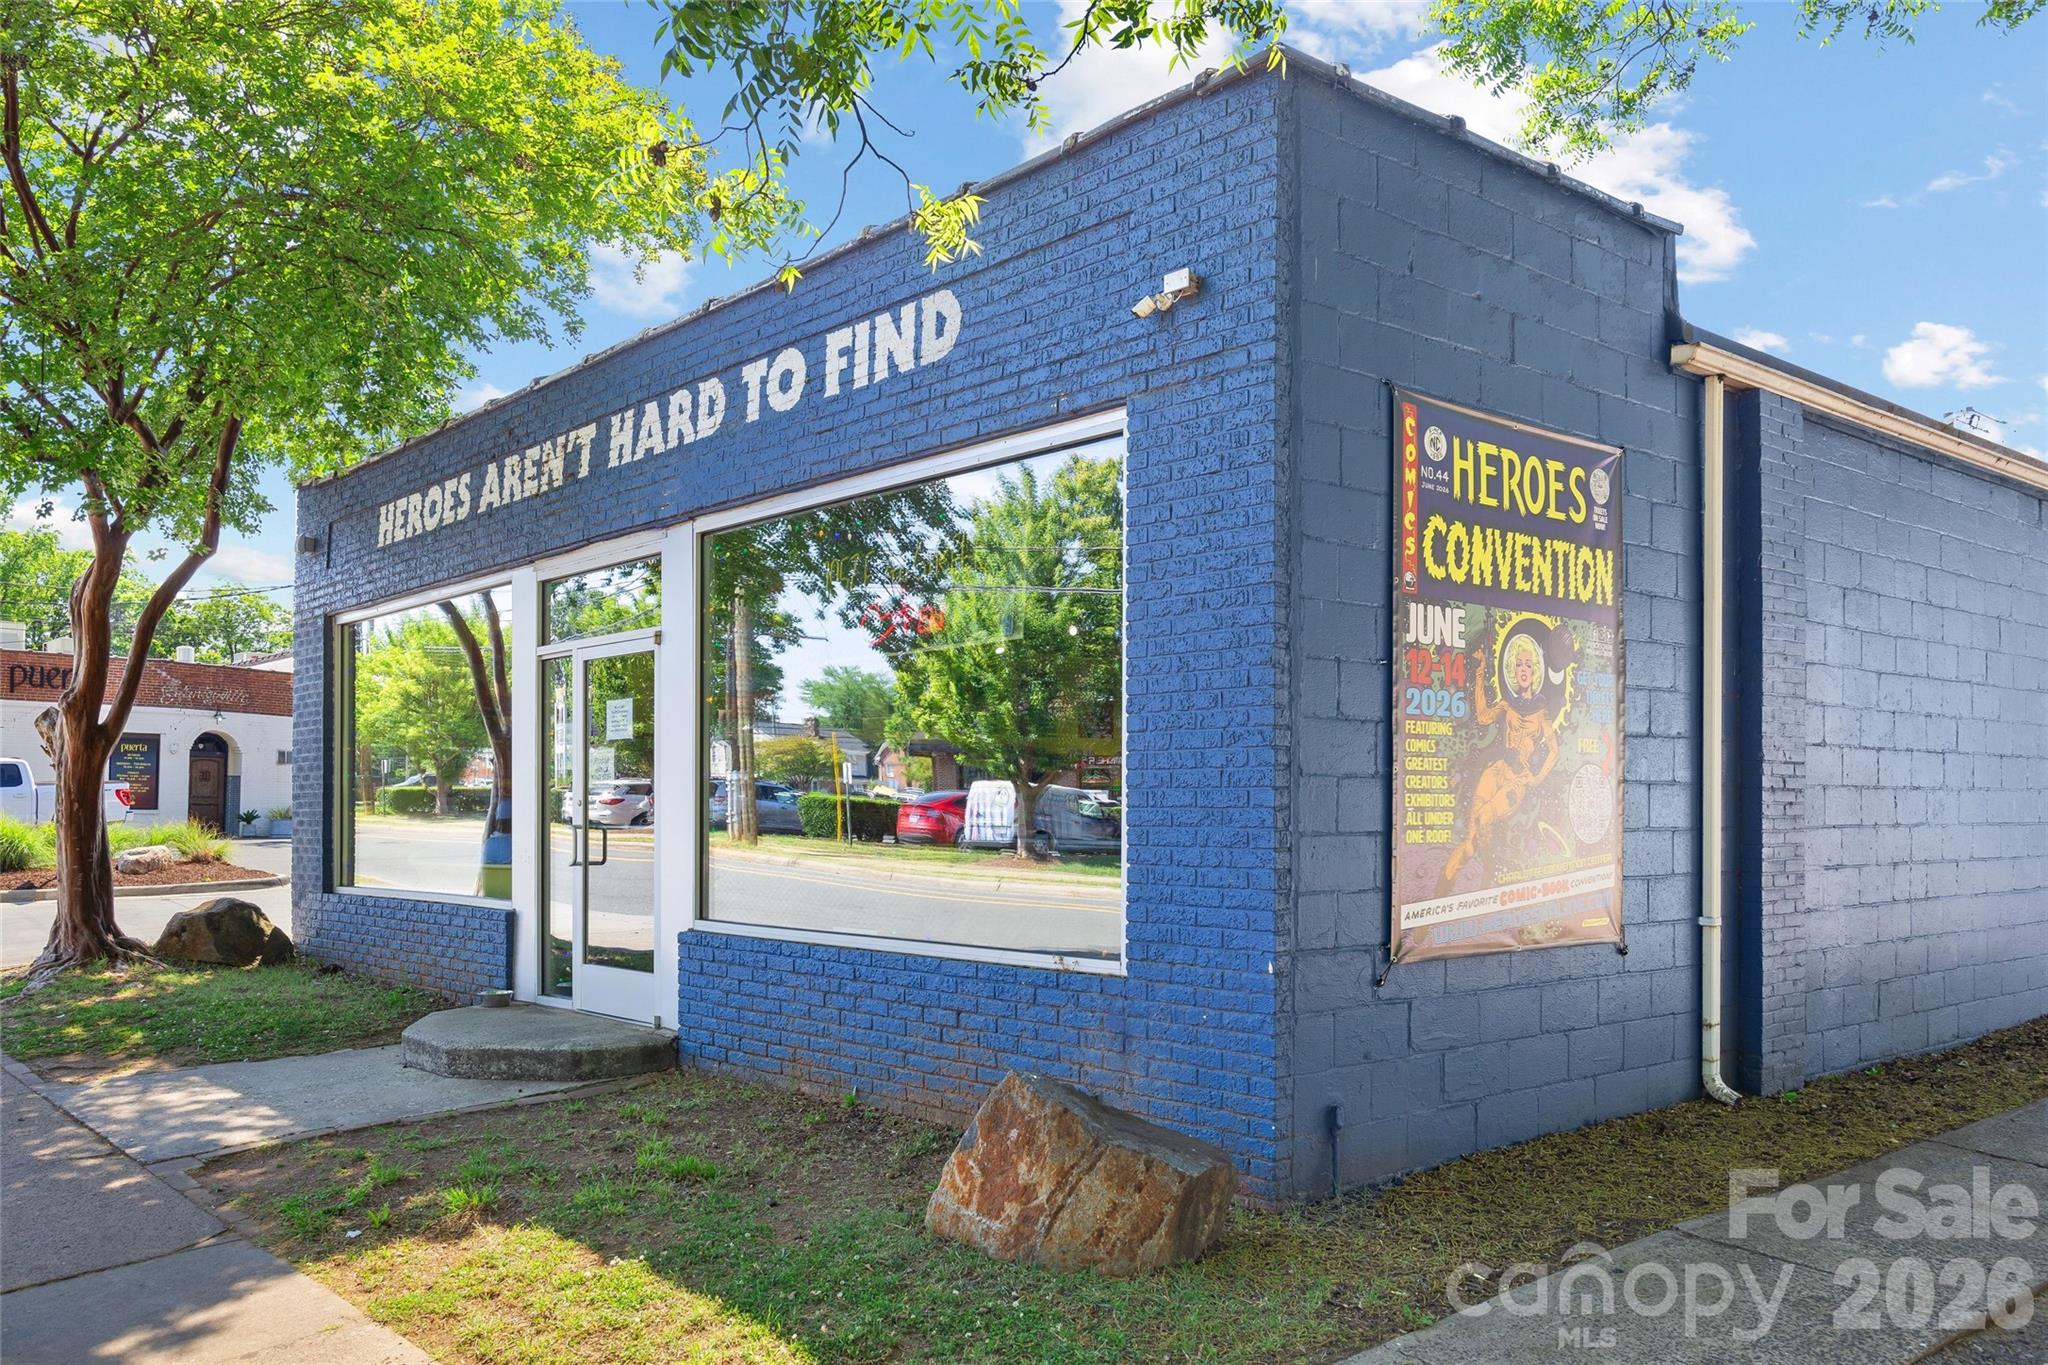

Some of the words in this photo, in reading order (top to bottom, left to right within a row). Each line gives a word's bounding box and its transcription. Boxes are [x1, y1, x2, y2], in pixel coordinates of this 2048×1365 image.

[377, 473, 471, 548] HEROES
[478, 422, 597, 513] AREN'T
[608, 377, 726, 468] HARD
[742, 347, 807, 424] TO
[824, 289, 963, 398] FIND
[1420, 465, 1449, 483] NO.44
[1452, 435, 1587, 524] HEROES
[1404, 416, 1417, 556] COMICS
[1421, 513, 1614, 606] CONVENTION
[1406, 602, 1466, 649] JUNE
[8, 663, 73, 693] puer
[1406, 648, 1466, 688] 12-14
[1406, 687, 1467, 718] 2026
[1405, 719, 1453, 736] FEATURING
[121, 743, 148, 752] puerta
[1405, 738, 1436, 752] COMICS
[1405, 756, 1448, 771] GREATEST
[1405, 775, 1449, 789] CREATORS
[1405, 793, 1456, 808] EXHIBITORS
[1406, 811, 1422, 825] ALL
[1424, 811, 1454, 826] UNDER
[1406, 829, 1425, 843] ONE
[1404, 903, 1454, 920] AMERICA'S
[1456, 895, 1498, 910] FAVORITE
